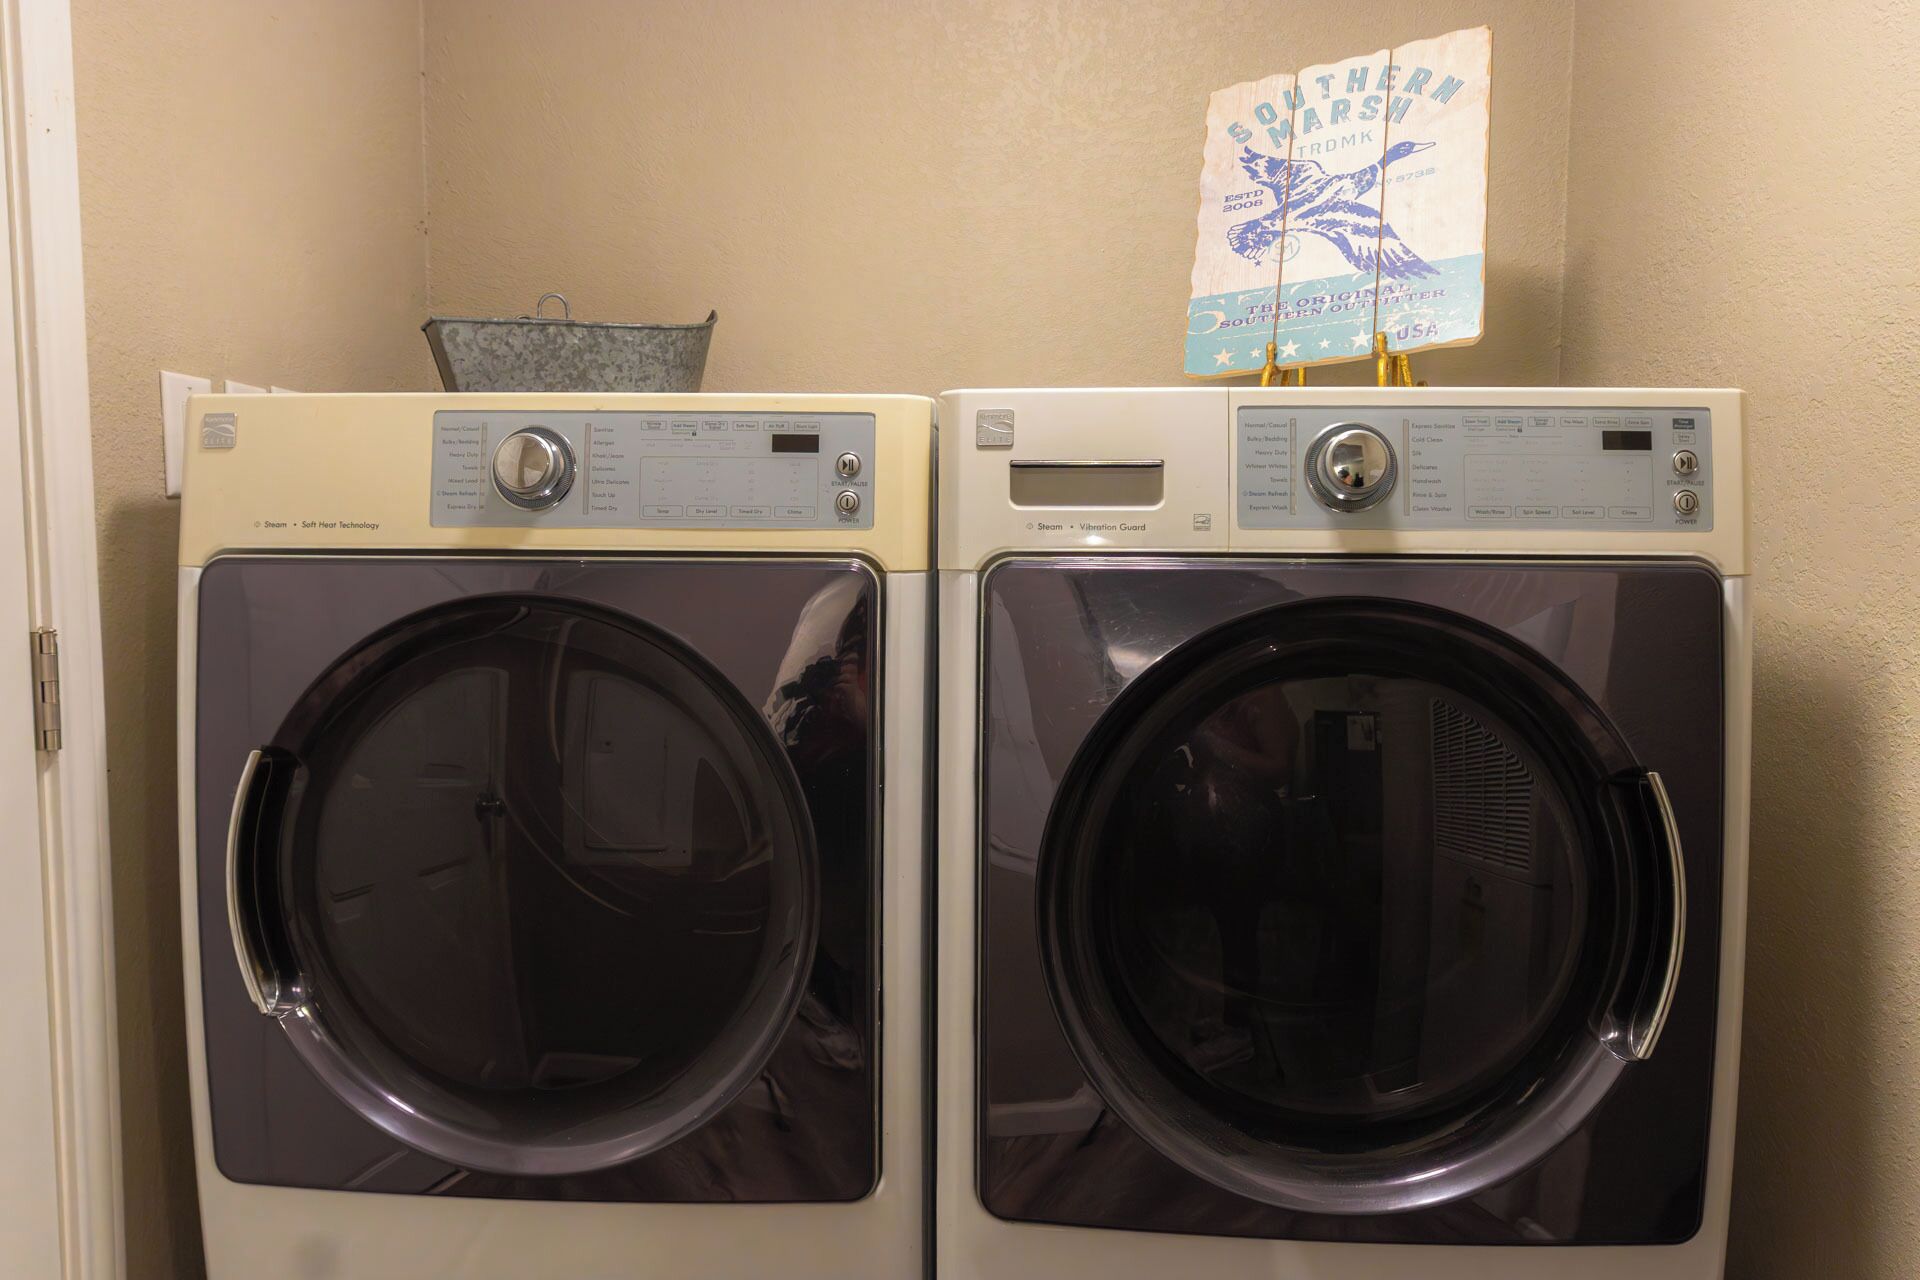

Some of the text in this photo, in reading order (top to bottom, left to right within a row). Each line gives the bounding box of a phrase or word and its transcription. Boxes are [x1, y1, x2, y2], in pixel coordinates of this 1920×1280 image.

[1227, 65, 1465, 144] SOUTHERN
[1266, 94, 1413, 149] MARSH
[1297, 129, 1373, 158] TRDMK
[1224, 189, 1264, 203] ESTD
[1222, 199, 1263, 213] 2008
[1246, 283, 1412, 315] THE ORIGINAL
[1220, 289, 1448, 329] SOUTHERN OUTFITTER
[1397, 322, 1439, 341] USA
[1249, 504, 1270, 512] Express
[264, 520, 380, 531] Steam Soft Heat Technology
[1037, 522, 1146, 531] Steam Vibration Guard
